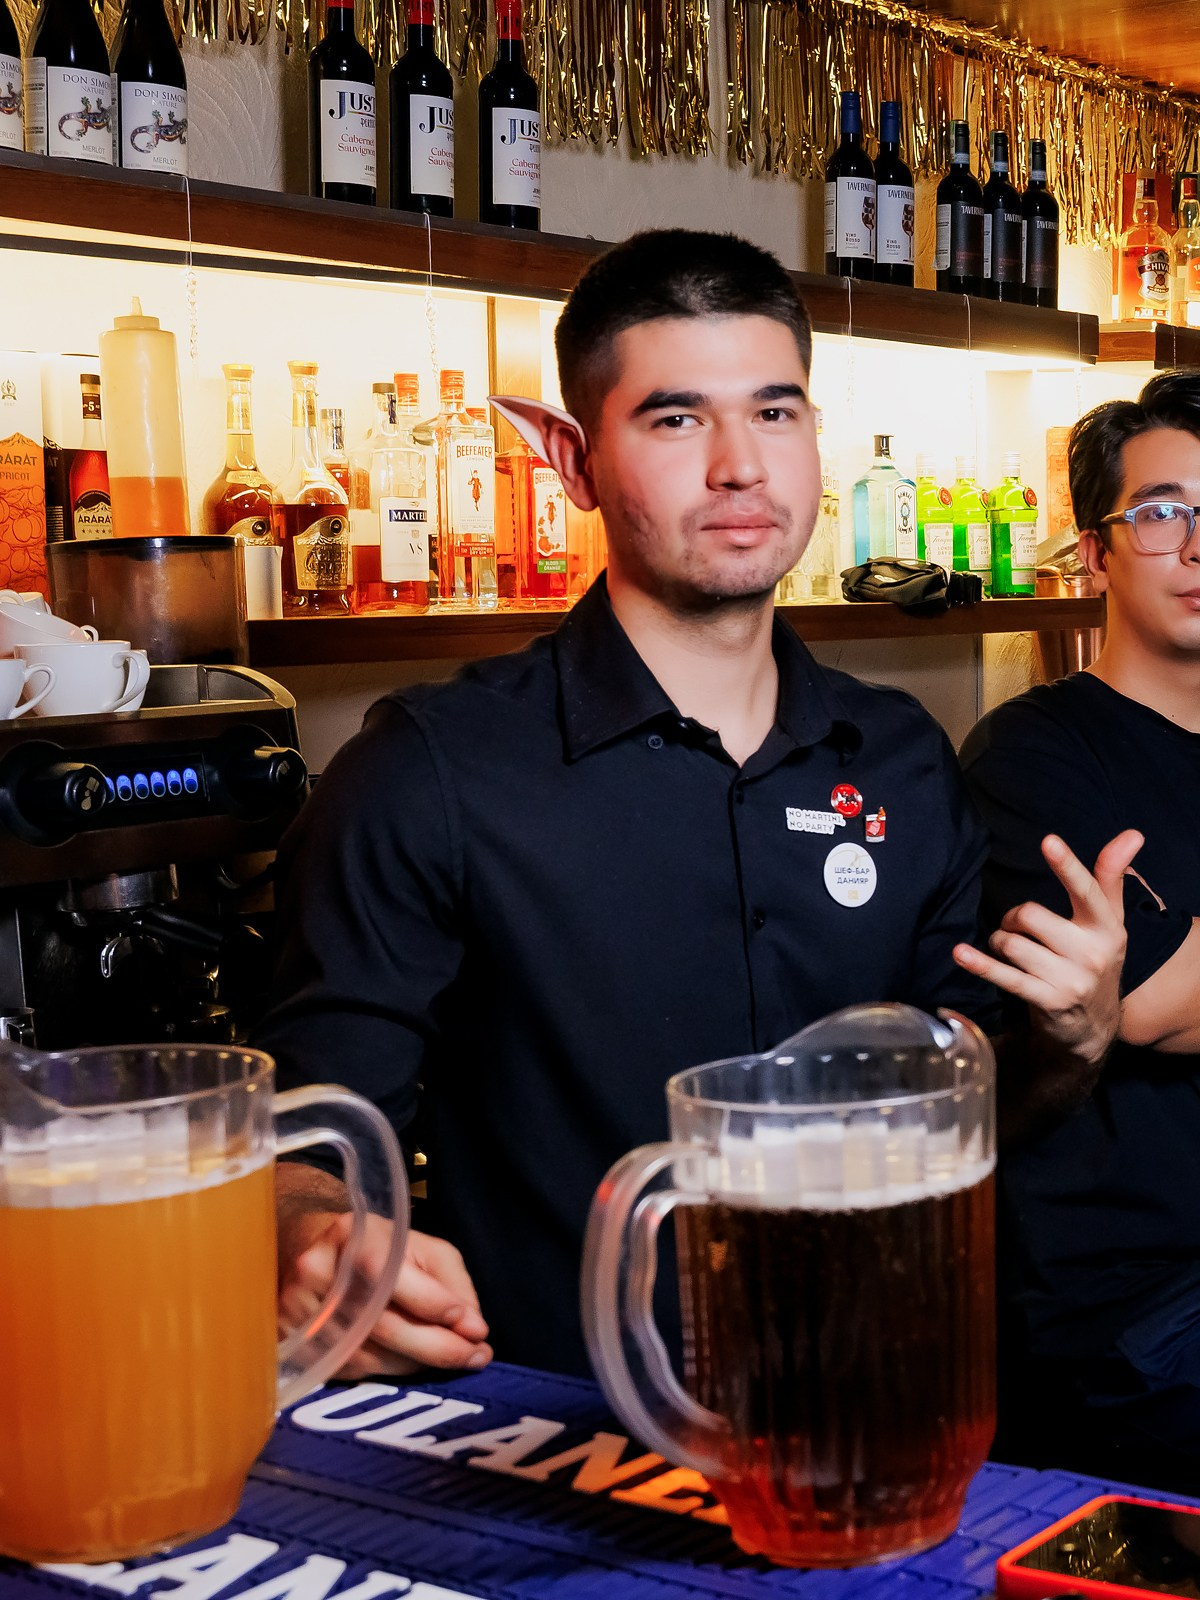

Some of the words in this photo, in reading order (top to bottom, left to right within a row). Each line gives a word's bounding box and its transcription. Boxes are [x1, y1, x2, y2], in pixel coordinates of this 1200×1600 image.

[63, 74, 87, 85] DON
[91, 79, 111, 89] SIMO
[82, 86, 104, 95] NATURE
[134, 88, 159, 98] DON
[500, 118, 540, 145] JUS
[82, 144, 105, 154] MERLOT
[153, 157, 178, 166] MERLOT
[88, 401, 95, 411] 5
[456, 445, 493, 459] BEEFEATER
[535, 473, 560, 484] BEEFEAT
[789, 810, 802, 818] NO
[790, 821, 803, 829] NO
[806, 823, 833, 832] PARTY
[834, 867, 870, 875] ШЕФ-БАР
[837, 877, 869, 885] ДАНИЯР
[292, 1383, 732, 1526] ULANE
